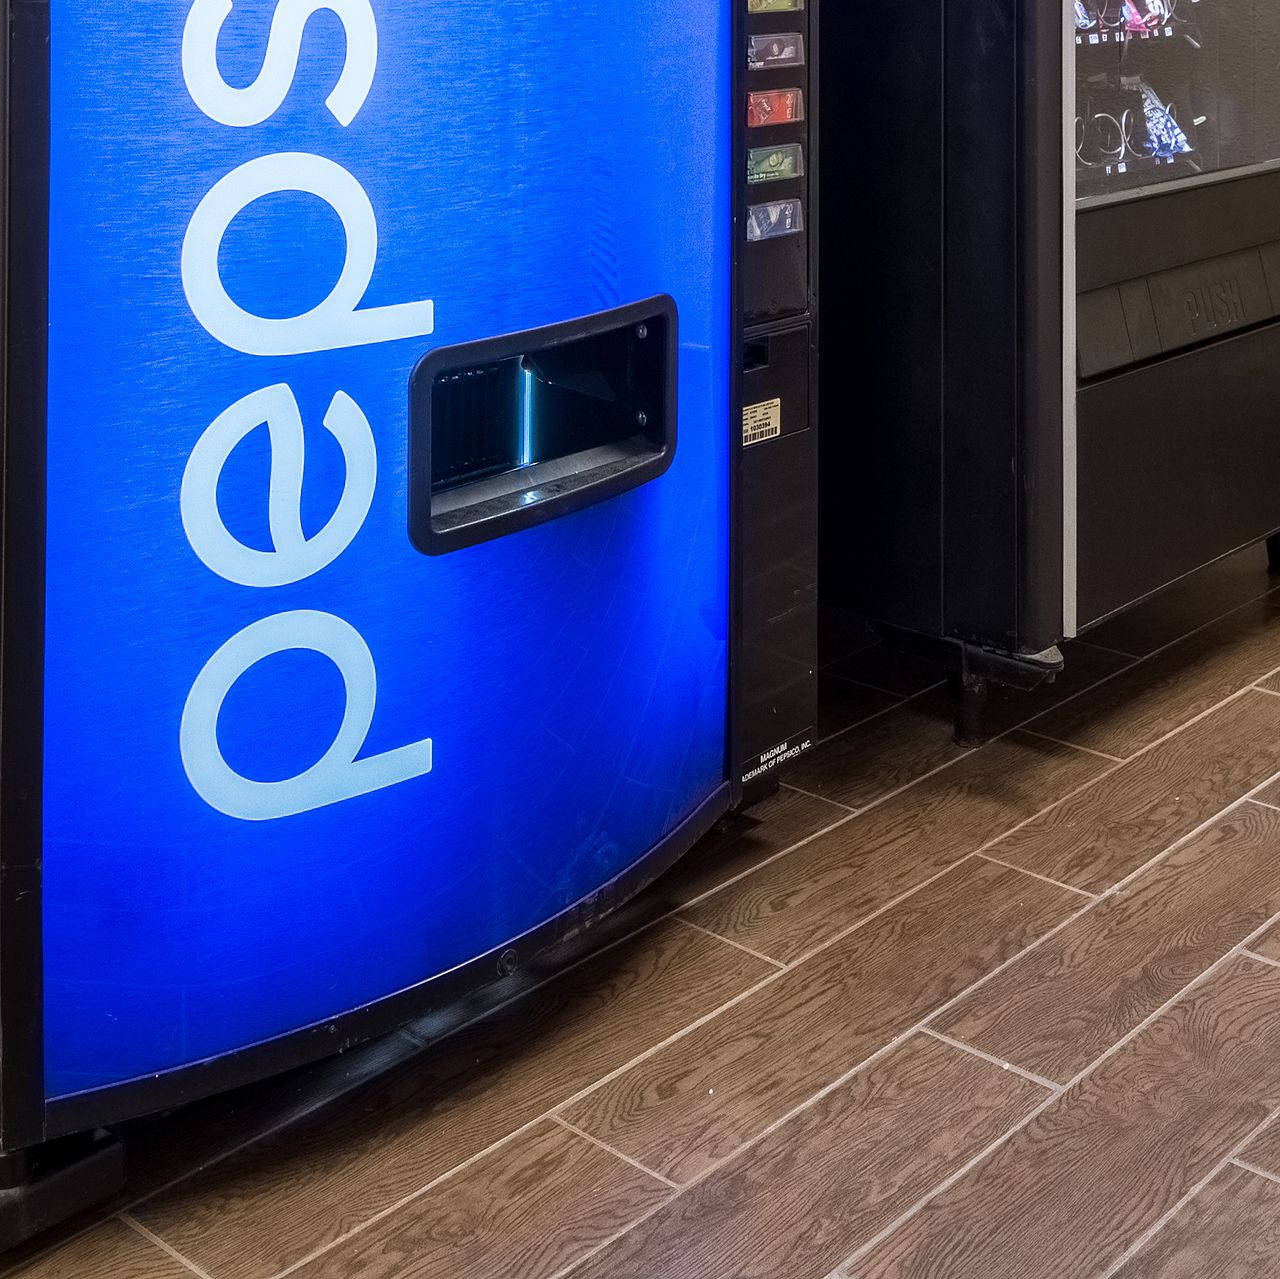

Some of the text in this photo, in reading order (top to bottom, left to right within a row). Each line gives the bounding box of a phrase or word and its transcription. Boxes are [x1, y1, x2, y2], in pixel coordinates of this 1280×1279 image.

[1181, 278, 1246, 336] PUSH
[750, 421, 771, 432] 1030394
[741, 739, 812, 782] ADEMARK OF PEPSICO, INC.
[760, 742, 788, 764] MAGNUM
